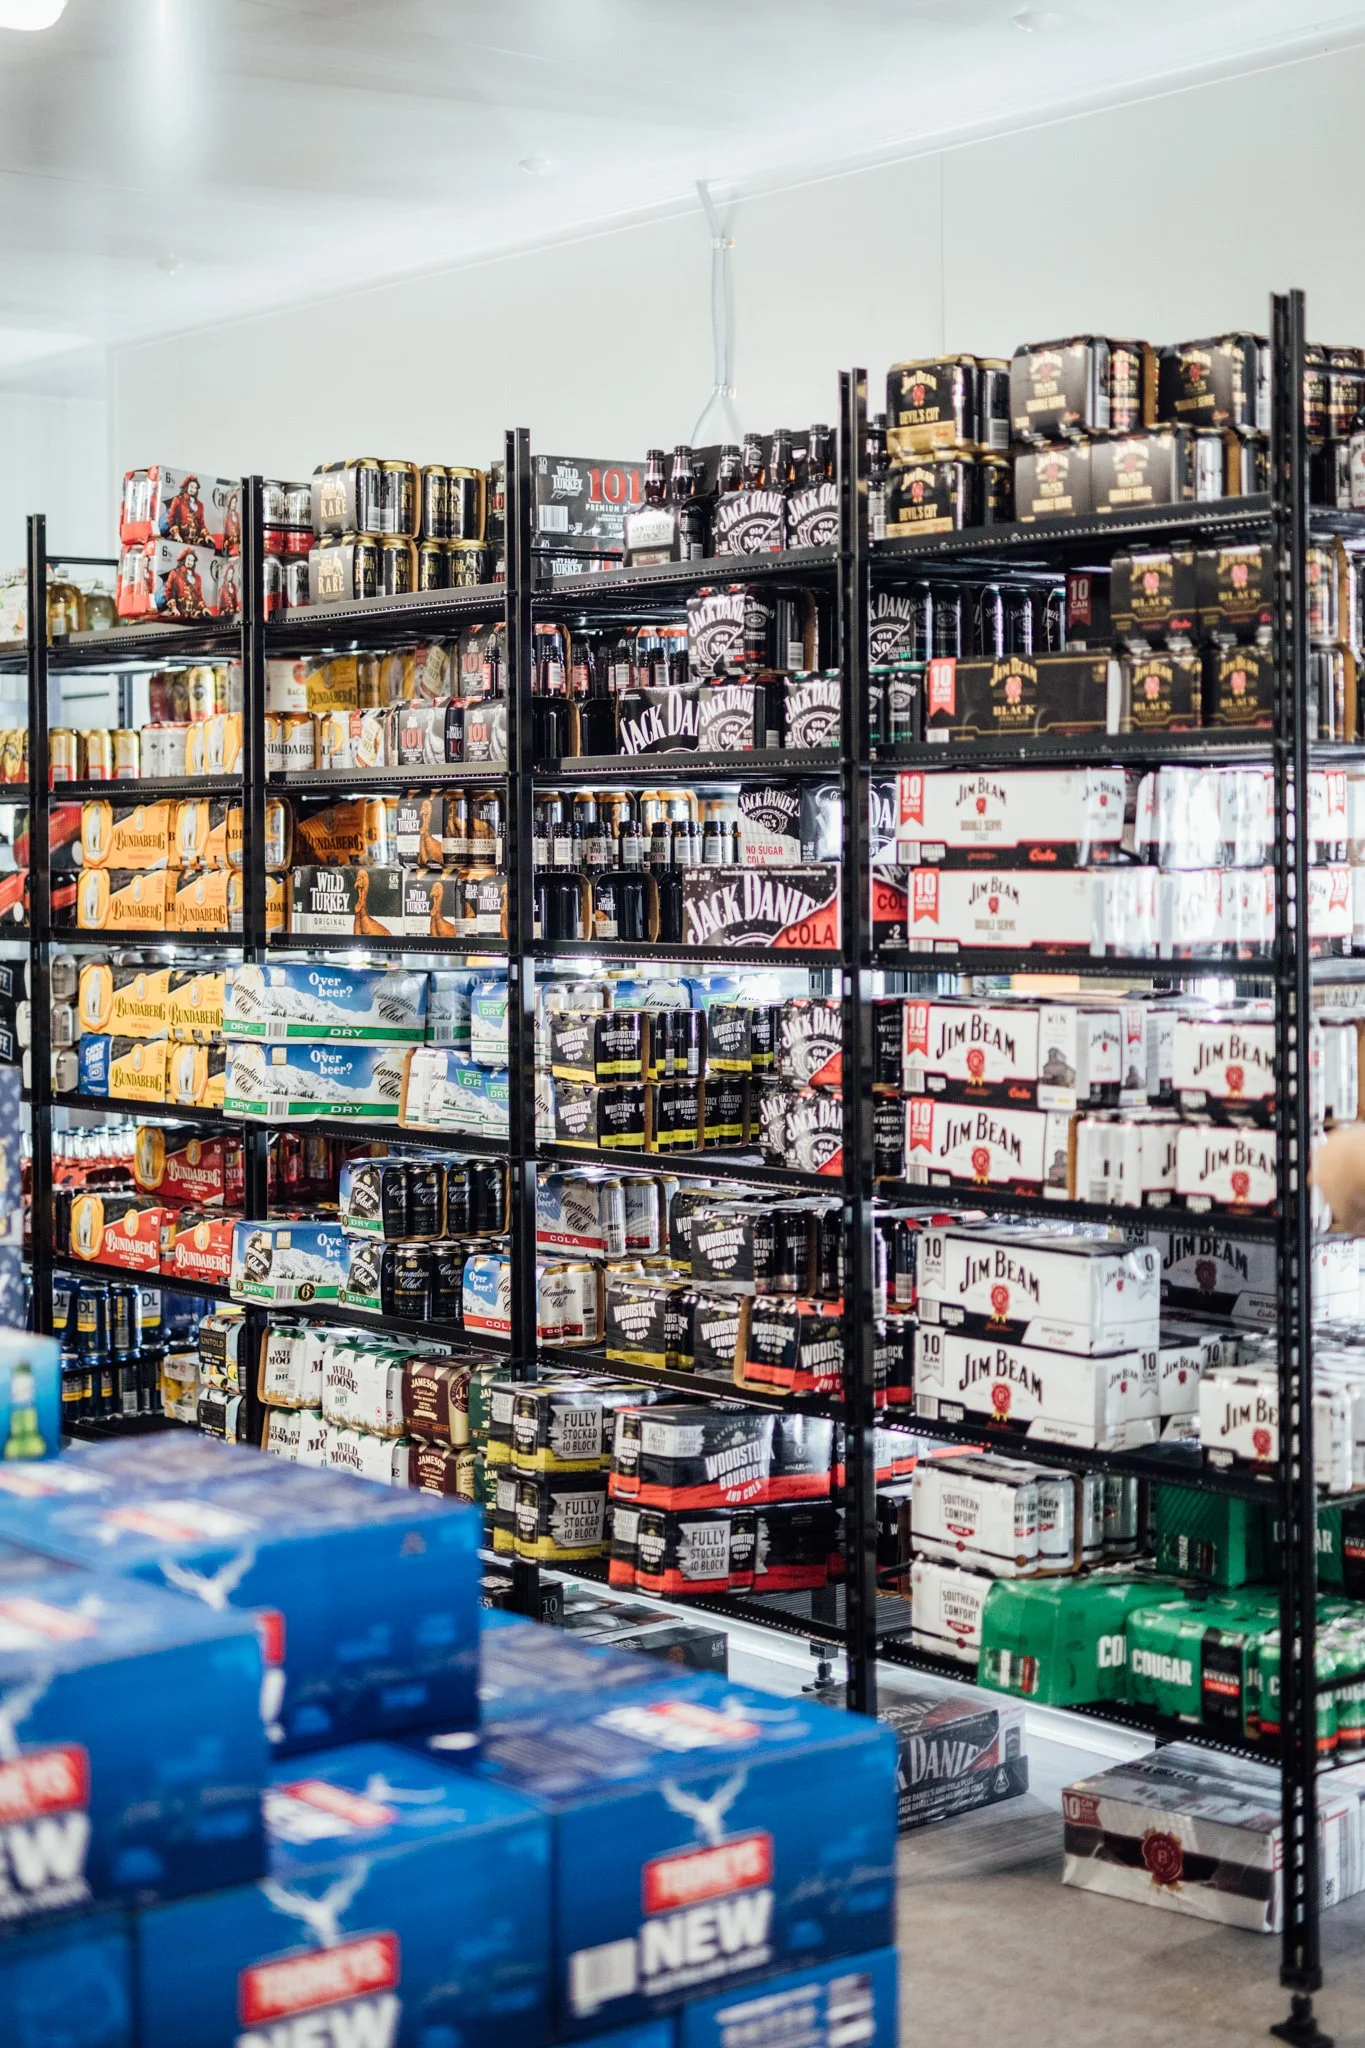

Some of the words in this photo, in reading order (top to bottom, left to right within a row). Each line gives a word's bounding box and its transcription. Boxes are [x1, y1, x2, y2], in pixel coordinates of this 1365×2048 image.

[556, 466, 578, 479] WILD
[551, 476, 583, 491] TURKEY
[587, 468, 641, 504] 101
[320, 500, 347, 518] RARE
[719, 497, 749, 532] JACK
[787, 488, 819, 526] JACK
[749, 527, 763, 535] Old
[819, 521, 833, 529] Old
[318, 575, 344, 594] RARE
[1070, 579, 1088, 600] 10
[1071, 601, 1088, 609] CAN
[687, 602, 715, 637] JACK
[714, 633, 728, 641] Old
[932, 666, 952, 687] 10
[700, 692, 725, 727] JACK
[785, 689, 811, 723] JACK
[993, 705, 1035, 715] BLACK
[468, 725, 488, 742] 101
[620, 704, 662, 754] JACK
[725, 724, 739, 732] Old
[812, 720, 826, 729] Old
[401, 728, 423, 748] 101
[901, 776, 922, 797] 10
[956, 784, 975, 806] JIM
[978, 777, 1007, 805] BEAM
[739, 792, 764, 813] JACK
[763, 787, 800, 816] DANIEL'S
[401, 807, 417, 820] WILD
[397, 819, 420, 832] TURKEY
[115, 830, 165, 850] BUNDABERG
[302, 831, 363, 851] BUNDABERG
[745, 845, 758, 855] NO
[759, 846, 783, 856] SUGAR
[317, 871, 345, 891] WILD
[915, 873, 936, 895] 10
[409, 889, 427, 901] WILD
[482, 886, 499, 898] WILD
[968, 882, 988, 905] JIM
[990, 876, 1020, 904] BEAM
[113, 900, 162, 920] BUNDABERG
[310, 889, 350, 913] TURKEY
[405, 900, 430, 914] TURKEY
[479, 898, 500, 911] TURKEY
[177, 905, 226, 925] BUNDABERG
[314, 917, 346, 926] ORIGINAL
[685, 883, 739, 944] JACK
[786, 923, 836, 945] COLA
[309, 973, 341, 986] Over
[318, 986, 353, 998] beer?
[115, 996, 166, 1020] BUNDABERG
[169, 1003, 224, 1026] BUNDABERG
[379, 1001, 405, 1023] Club
[482, 1007, 501, 1016] DRY
[908, 1006, 926, 1028] 10
[231, 1022, 249, 1031] DRY
[330, 1028, 363, 1037] DRY
[712, 1020, 746, 1038] WOODSTOCK
[781, 1013, 812, 1049] JACK
[556, 1027, 589, 1046] WOODSTOCK
[936, 1019, 966, 1059] JIM
[970, 1014, 1016, 1064] BEAM
[562, 1041, 584, 1053] BOURBON
[813, 1048, 827, 1057] Old
[311, 1050, 342, 1063] Over
[1194, 1043, 1224, 1075] JIM
[320, 1062, 352, 1075] beer?
[112, 1069, 162, 1090] BUNDABERG
[231, 1101, 250, 1110] DRY
[331, 1105, 362, 1114] DRY
[559, 1100, 592, 1120] WOODSTOCK
[760, 1094, 787, 1125] JACK
[912, 1103, 930, 1124] 10
[565, 1114, 587, 1125] BOURBON
[786, 1106, 817, 1141] JACK
[818, 1140, 833, 1150] Old
[941, 1119, 971, 1157] JIM
[977, 1112, 1021, 1165] BEAM
[168, 1160, 220, 1186] BUNDABERG
[1200, 1147, 1229, 1181] JIM
[561, 1191, 598, 1225] Canadian
[565, 1209, 588, 1233] Club
[105, 1229, 156, 1259] BUNDABERG
[550, 1235, 579, 1245] COLA
[697, 1228, 746, 1253] WOODSTOCK
[925, 1238, 942, 1258] 10
[175, 1244, 230, 1274] BUNDABERG
[706, 1245, 739, 1261] BOURBON
[1163, 1234, 1196, 1270] JIM
[469, 1272, 487, 1283] Over
[473, 1281, 493, 1292] beer?
[959, 1255, 990, 1293] JIM
[995, 1250, 1040, 1305] BEAM
[243, 1285, 263, 1294] DRY
[349, 1296, 368, 1304] DRY
[614, 1301, 657, 1324] WOODSTOCK
[621, 1317, 651, 1331] BOURBON
[201, 1337, 224, 1348] UNTOLD
[922, 1334, 940, 1354] 10
[923, 1355, 940, 1363] CAN
[1142, 1353, 1156, 1371] 10
[333, 1365, 353, 1379] WILD
[959, 1353, 990, 1390] JIM
[996, 1349, 1043, 1405] BEAM
[326, 1375, 358, 1395] MOOSE
[411, 1378, 438, 1393] JAMESON
[564, 1412, 597, 1427] FULLY
[1221, 1403, 1250, 1436] JIM
[563, 1429, 597, 1439] STOCKED
[337, 1442, 358, 1457] WILD
[563, 1442, 570, 1451] 10
[572, 1440, 596, 1451] BLOCK
[330, 1452, 363, 1472] MOOSE
[418, 1455, 447, 1471] JAMESON
[705, 1438, 775, 1481] WOODSTOCK
[719, 1464, 764, 1491] BOURBON
[726, 1489, 741, 1502] AND
[743, 1482, 762, 1499] COLA
[565, 1500, 599, 1515] FULLY
[943, 1494, 979, 1513] SOUTHERN
[564, 1516, 599, 1527] STOCKED
[944, 1507, 976, 1524] COMFORT
[564, 1529, 572, 1539] 10
[575, 1527, 598, 1538] BLOCK
[692, 1530, 725, 1546] FULLY
[951, 1526, 970, 1536] COLA
[690, 1547, 725, 1559] STOCKED
[701, 1559, 724, 1571] BLOCK
[542, 1598, 557, 1615] 10
[943, 1591, 979, 1609] SOUTHERN
[944, 1604, 976, 1620] COMFORT
[951, 1622, 970, 1632] COLA
[1132, 1650, 1192, 1687] COUGAR
[1063, 1795, 1080, 1819] 10
[641, 1890, 773, 1976] NEW
